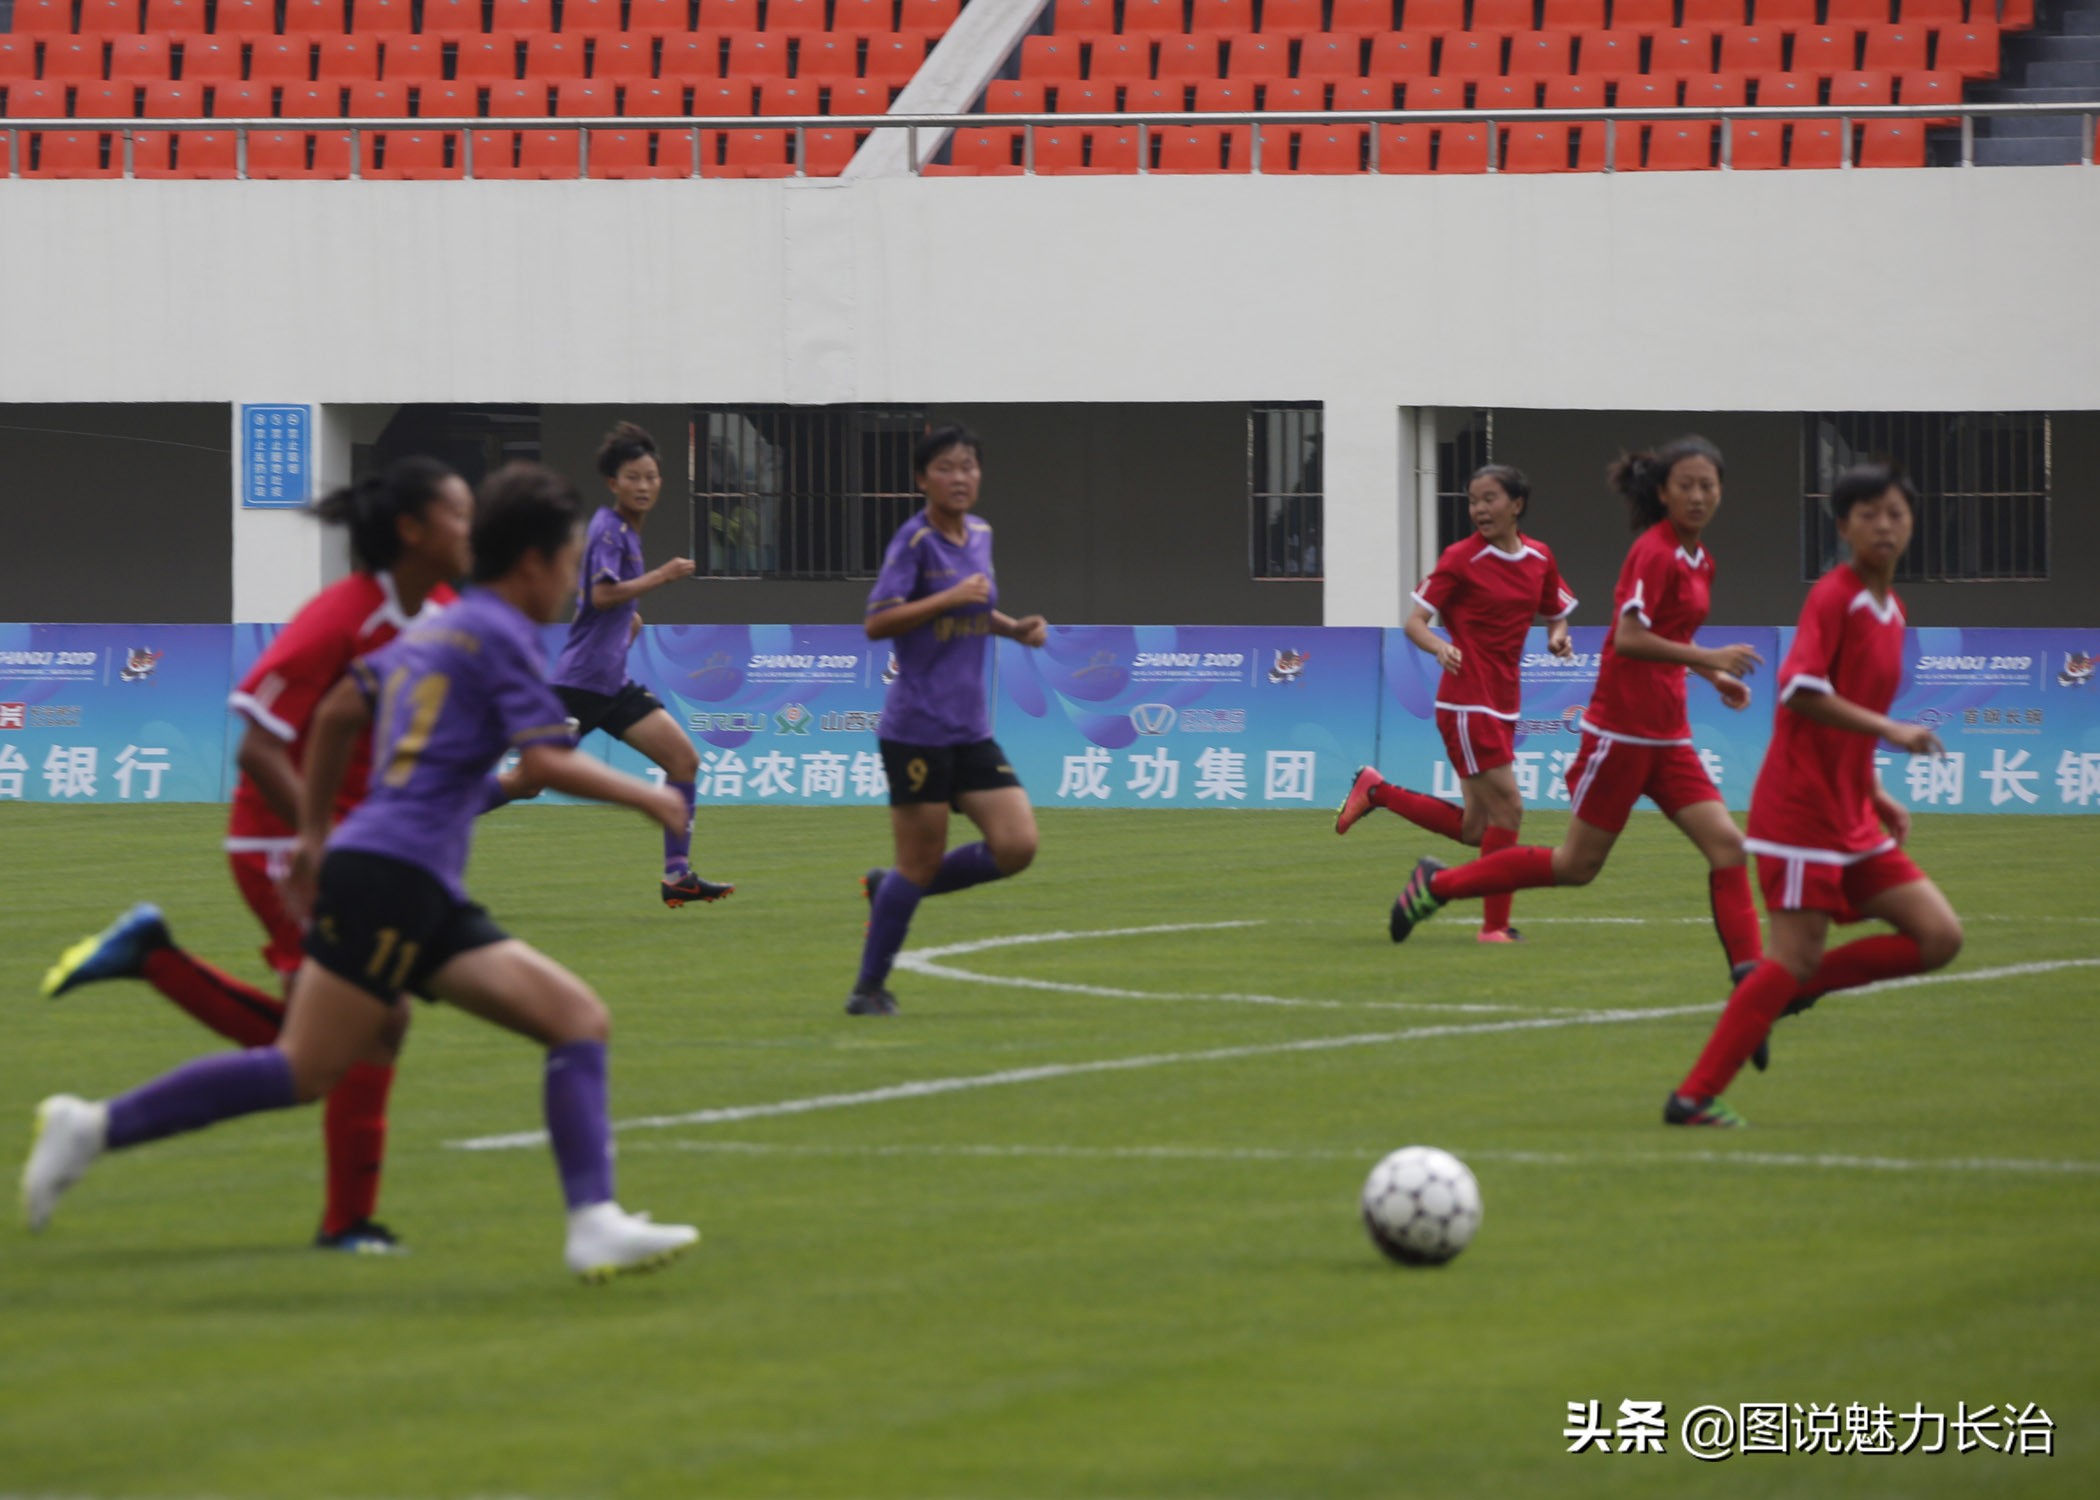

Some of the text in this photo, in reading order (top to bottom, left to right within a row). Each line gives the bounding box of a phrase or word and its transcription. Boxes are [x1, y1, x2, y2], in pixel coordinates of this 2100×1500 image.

[0, 652, 54, 665] HANXI
[816, 655, 858, 668] 2019
[1202, 653, 1244, 667] 2019
[1989, 655, 2032, 670] 2019
[688, 712, 767, 732] SRCU
[646, 750, 888, 798] 治农商银
[907, 757, 928, 792] 9
[1057, 746, 1317, 800] 成功集团
[366, 927, 420, 992] 11
